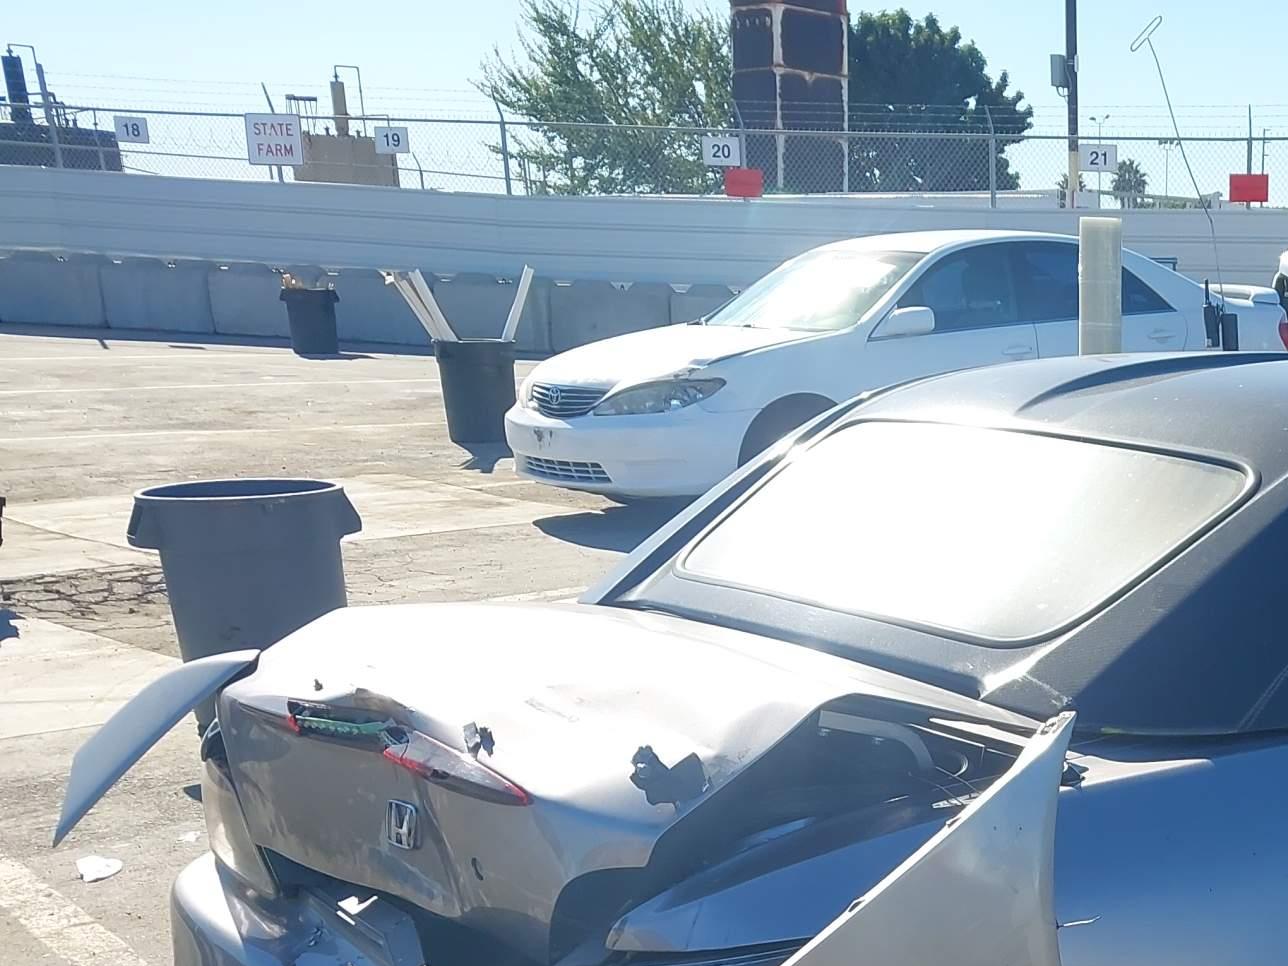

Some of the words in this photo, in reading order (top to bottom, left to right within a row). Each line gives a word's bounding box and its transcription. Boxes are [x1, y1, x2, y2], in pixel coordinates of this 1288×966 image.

[122, 122, 141, 137] 18
[253, 122, 294, 137] STATE
[383, 132, 401, 148] 19
[256, 142, 294, 157] FARM
[711, 143, 731, 159] 20
[1089, 150, 1107, 166] 21
